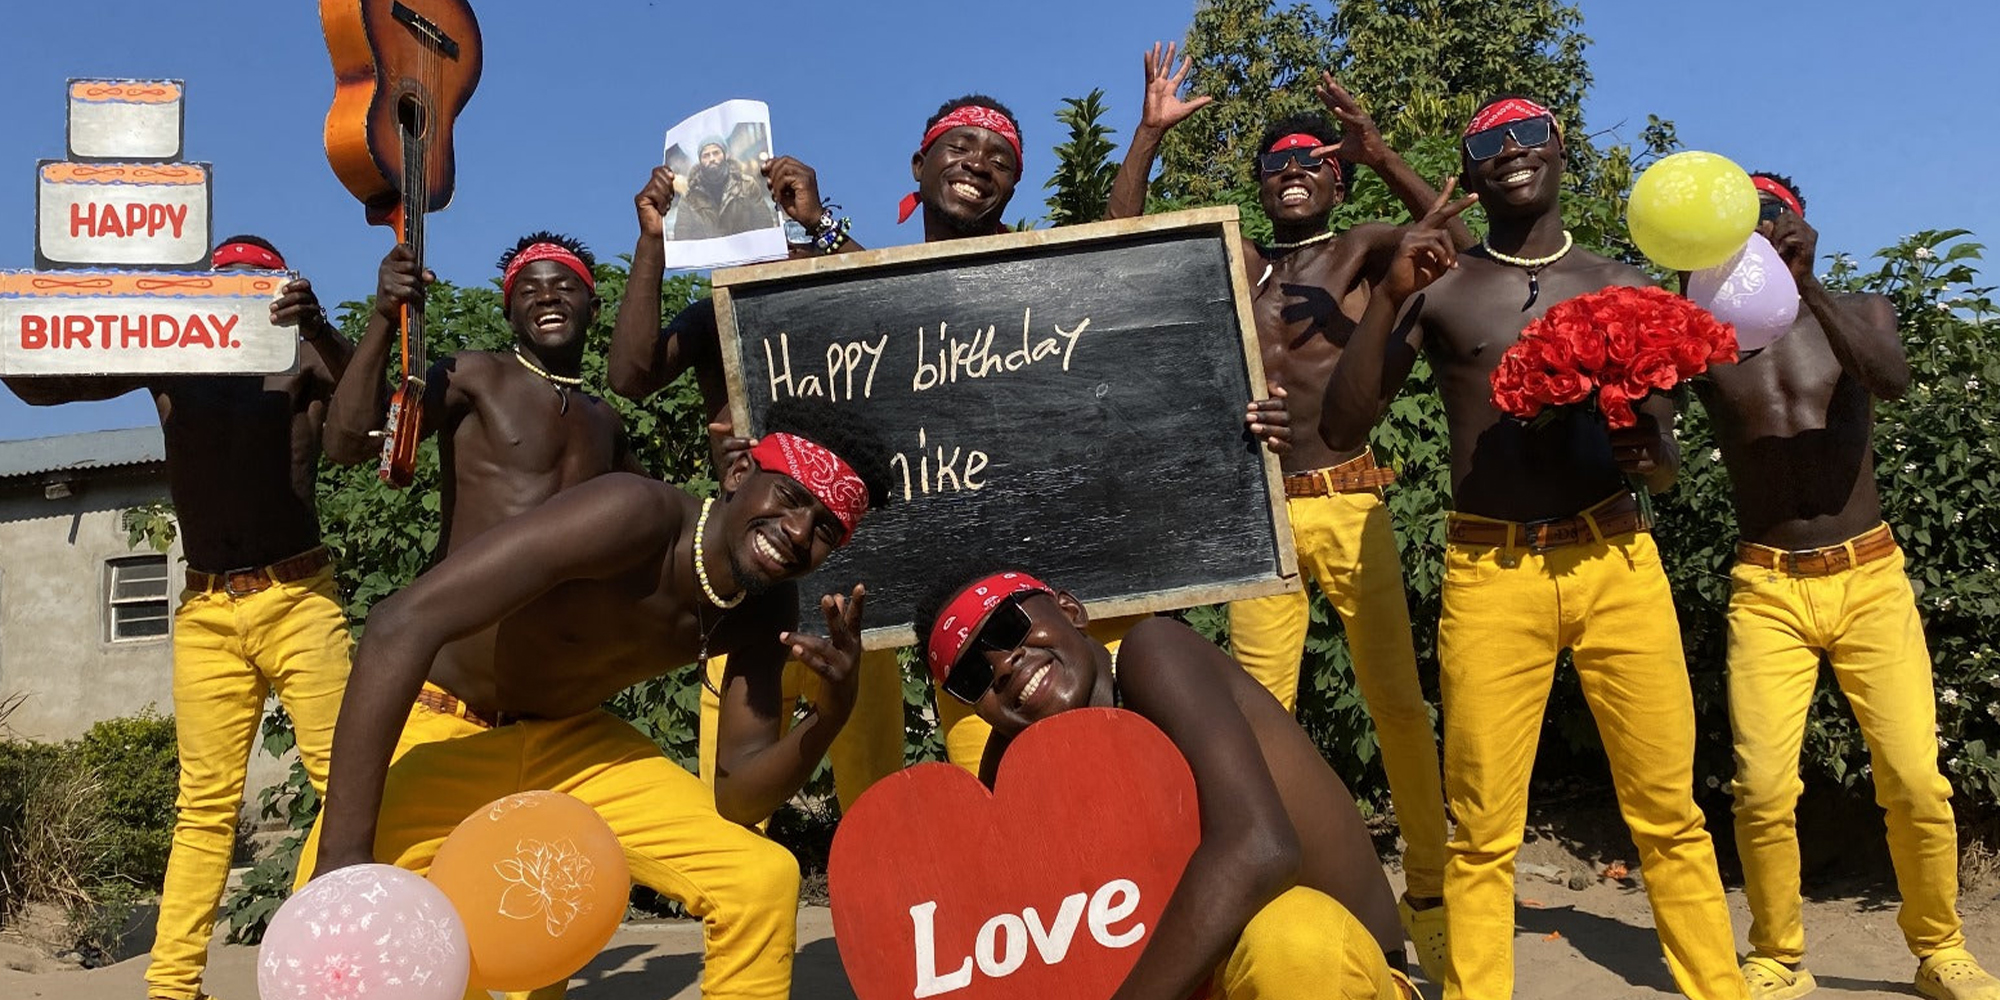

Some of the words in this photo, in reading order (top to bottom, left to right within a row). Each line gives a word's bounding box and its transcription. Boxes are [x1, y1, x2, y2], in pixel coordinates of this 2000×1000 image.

[70, 202, 188, 238] HAPPY
[20, 314, 242, 349] BIRTHDAY.
[763, 332, 889, 403] Happy
[912, 306, 1092, 393] birthday
[909, 878, 1146, 999] Love
